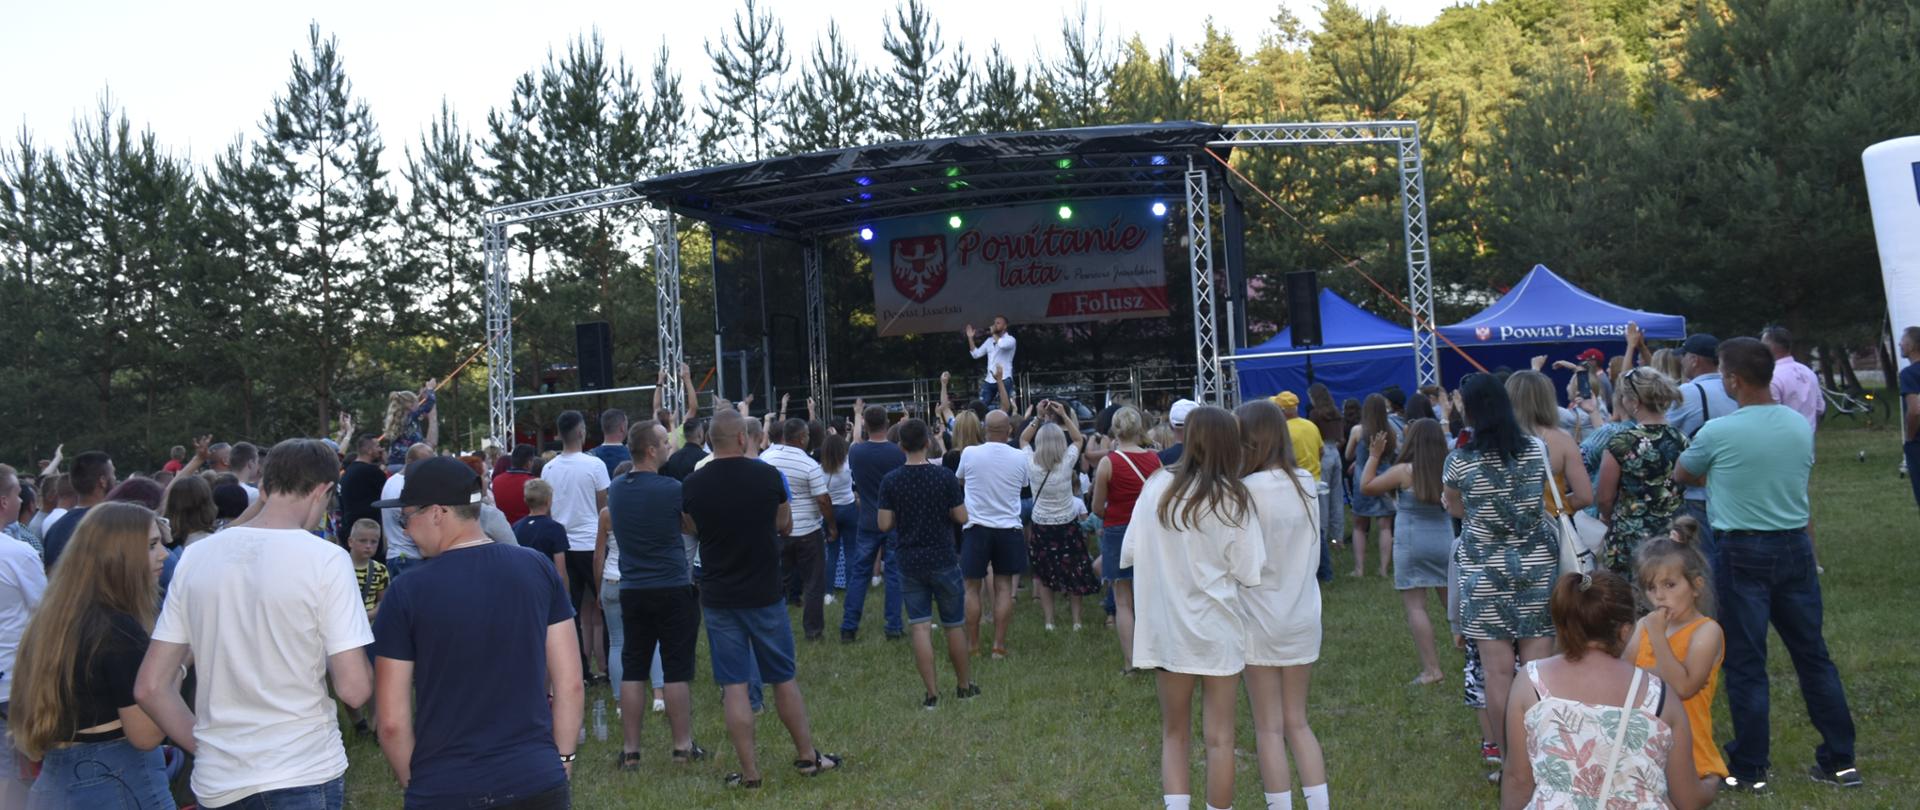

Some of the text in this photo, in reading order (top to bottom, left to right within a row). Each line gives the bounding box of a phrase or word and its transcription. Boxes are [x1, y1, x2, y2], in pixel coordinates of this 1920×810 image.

[958, 216, 1147, 266] Powitanie
[998, 260, 1062, 289] lata
[1074, 292, 1145, 313] Folusz
[883, 308, 918, 320] Powiat
[1501, 325, 1563, 340] Powiat
